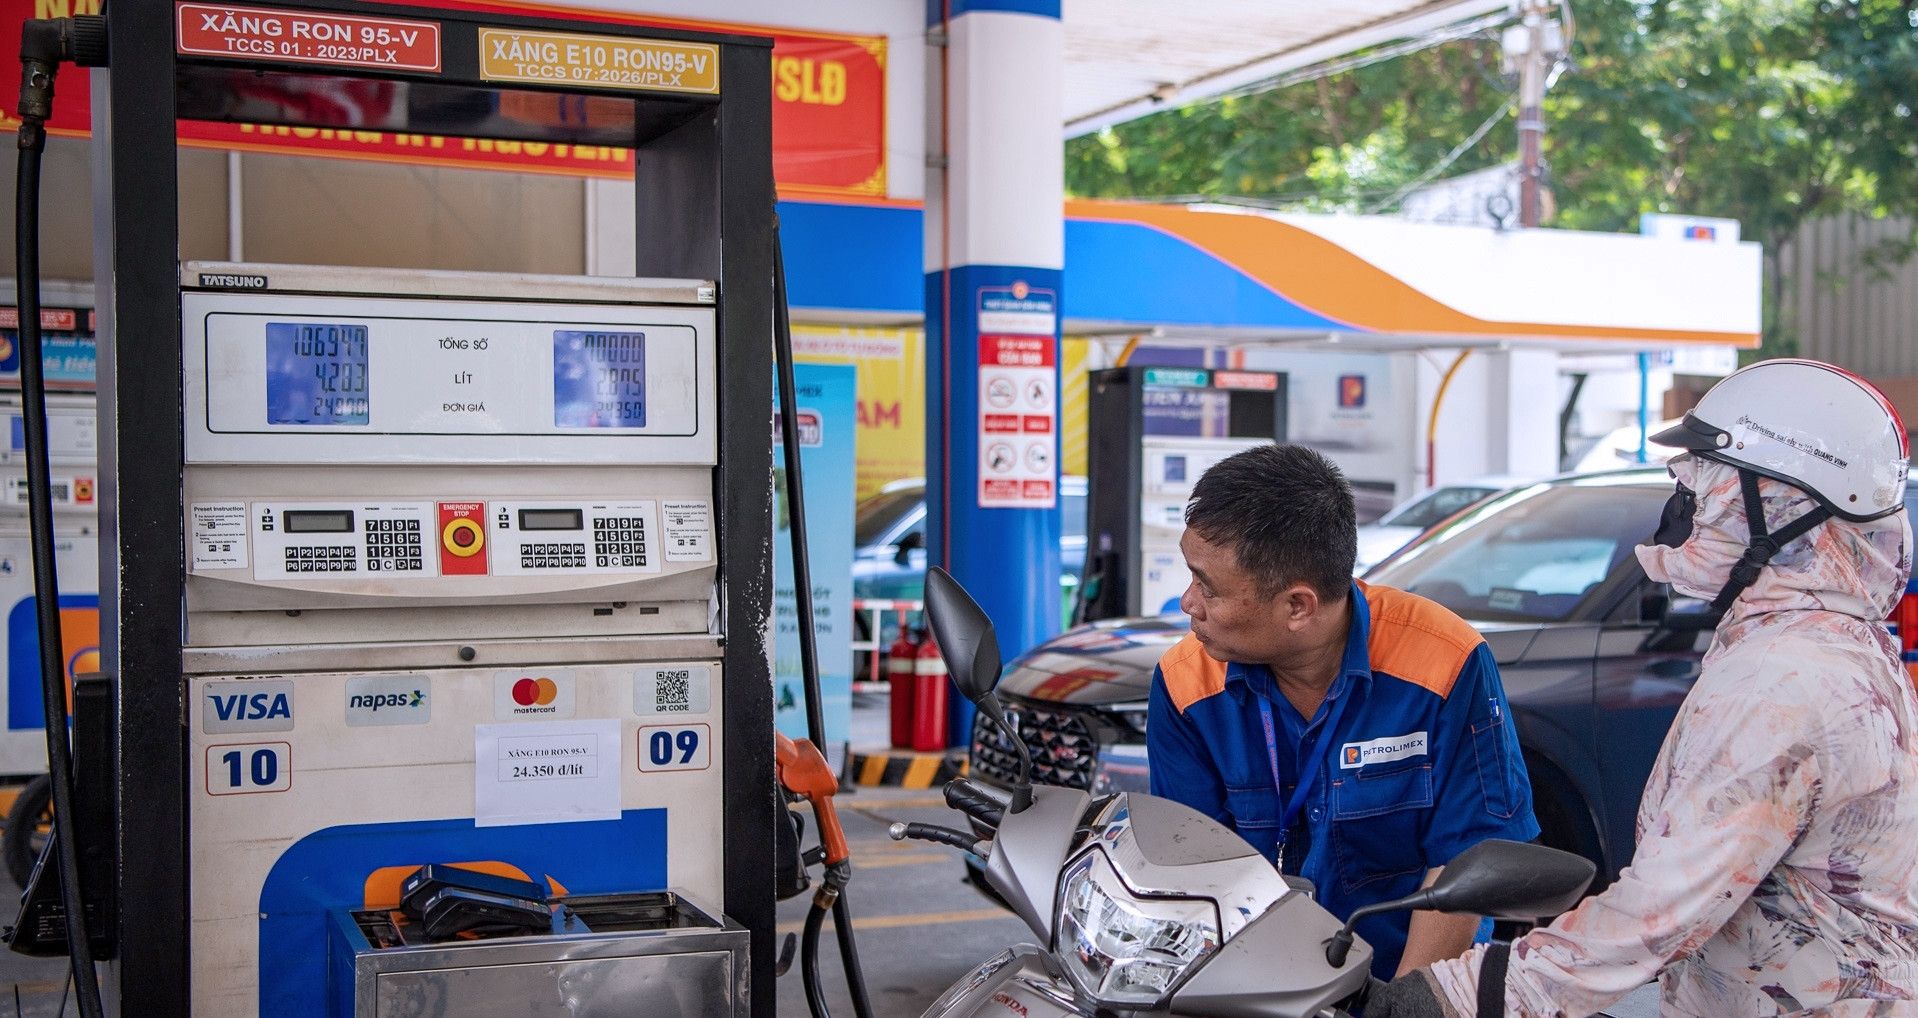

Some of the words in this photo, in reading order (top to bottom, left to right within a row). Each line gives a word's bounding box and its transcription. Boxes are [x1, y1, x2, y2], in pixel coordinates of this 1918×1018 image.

[200, 11, 283, 37] XĂNG
[292, 20, 352, 42] RON
[360, 27, 419, 48] 95-V
[224, 37, 275, 54] TCCS
[280, 41, 301, 56] 01
[317, 44, 398, 63] 2023/PLX
[491, 34, 559, 64] XĂNG
[566, 43, 607, 67] E10
[613, 47, 708, 75] RON95-V
[514, 62, 567, 79] TCCS
[572, 67, 683, 87] 07:2026/PLX
[202, 274, 265, 288] TATSUNO
[294, 326, 366, 357] 106947
[438, 336, 469, 350] TỔNG
[473, 337, 489, 350] SỐ
[585, 334, 642, 363] 70000
[454, 370, 473, 385] LÍT
[443, 402, 465, 412] ĐƠN
[467, 401, 486, 412] GIÁ
[597, 401, 642, 419] 24350
[1751, 422, 1776, 438] Driving
[1813, 448, 1834, 462] QUANG
[1834, 457, 1848, 469] VINH
[369, 522, 376, 530] 7
[382, 522, 389, 530] 8
[396, 522, 403, 530] 9
[609, 520, 616, 528] 8
[369, 535, 376, 543] 4
[383, 535, 390, 543] 5
[397, 535, 404, 543] 6
[597, 532, 604, 540] 4
[610, 532, 616, 540] 5
[623, 532, 629, 540] 6
[371, 548, 375, 556] 1
[384, 548, 390, 556] 2
[398, 548, 404, 556] 3
[599, 545, 603, 553] 1
[611, 545, 617, 553] 2
[623, 545, 630, 553] 3
[370, 561, 377, 569] 0
[384, 561, 392, 569] C
[523, 558, 533, 566] P6
[536, 558, 546, 566] P7
[549, 558, 559, 566] P8
[562, 558, 572, 566] P9
[574, 558, 586, 566] P10
[599, 558, 605, 566] 0
[611, 558, 619, 566] C
[206, 693, 291, 720] VISA
[350, 693, 407, 711] napas
[668, 704, 690, 712] CODE
[513, 706, 556, 714] mastercard
[508, 749, 533, 758] XĂNG
[535, 749, 549, 757] E10
[551, 749, 569, 757] RON
[571, 747, 589, 756] 95-V
[649, 730, 699, 765] 09
[222, 748, 278, 787] 10
[513, 765, 554, 778] 24.350
[558, 763, 584, 777] đ/lít
